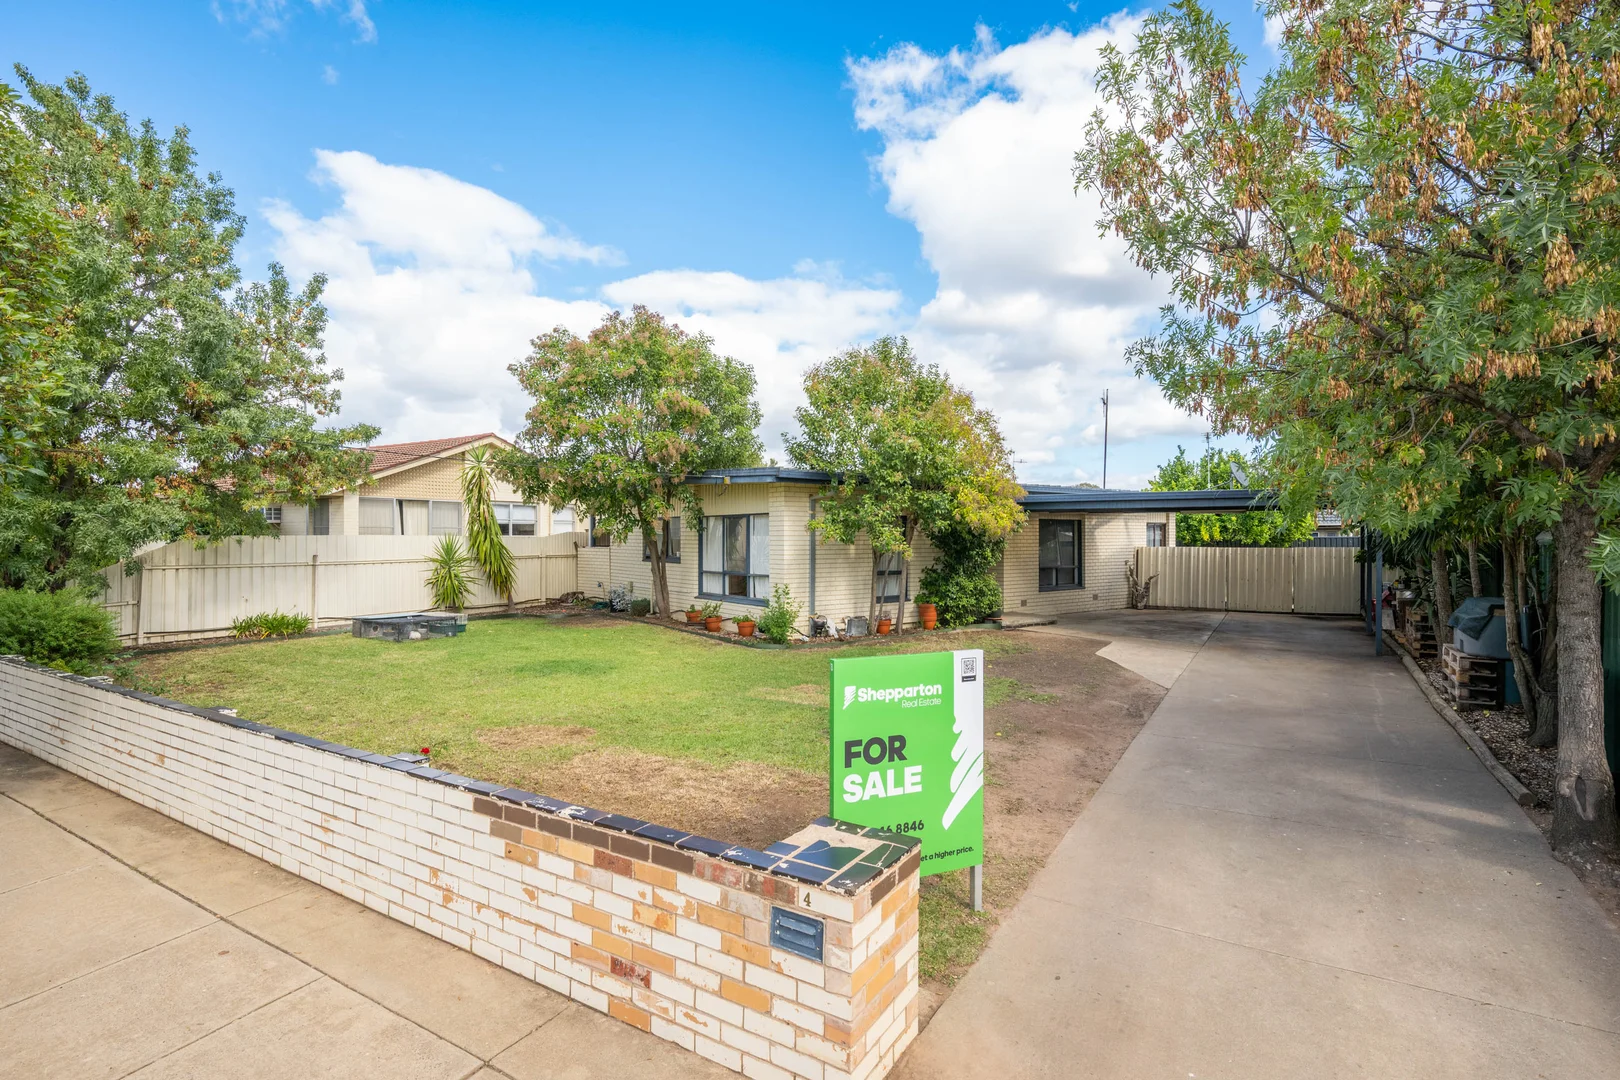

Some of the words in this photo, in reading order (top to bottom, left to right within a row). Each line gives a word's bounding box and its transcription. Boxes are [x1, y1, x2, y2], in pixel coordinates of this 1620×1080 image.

[857, 683, 942, 703] Shepparton
[901, 699, 918, 709] Real
[919, 697, 941, 707] Estate
[844, 734, 908, 769] FOR
[842, 764, 923, 803] SALE
[895, 819, 925, 834] 8846
[920, 854, 928, 862] et
[934, 850, 955, 860] higher
[956, 846, 975, 856] price.
[803, 891, 812, 908] 4
